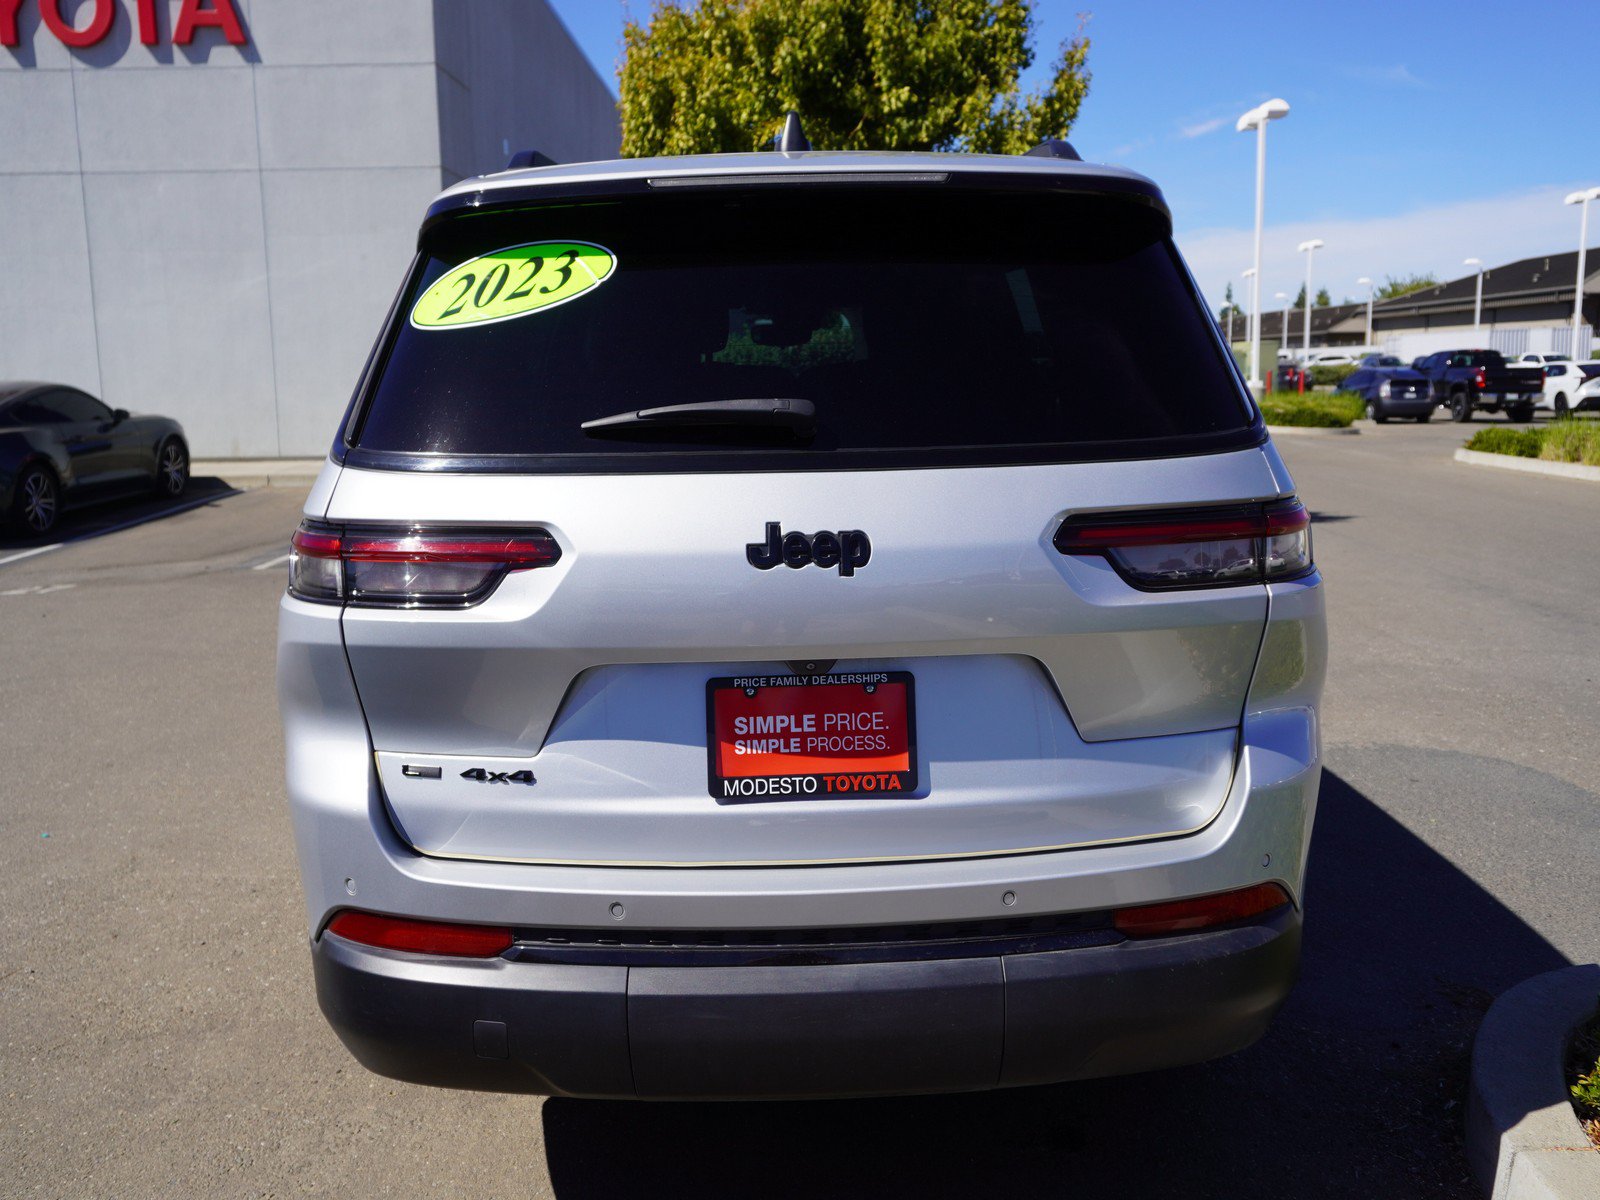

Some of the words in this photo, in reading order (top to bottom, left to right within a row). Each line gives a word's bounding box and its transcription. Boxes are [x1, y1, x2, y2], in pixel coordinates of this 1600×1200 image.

[437, 250, 579, 321] 2023
[746, 522, 872, 577] Jeep
[733, 677, 767, 688] PRICE
[770, 675, 808, 687] FAMILY
[812, 673, 888, 685] DEALERSHIPS
[734, 714, 816, 735] SIMPLE
[824, 711, 890, 731] PRICE.
[734, 737, 801, 755] SIMPLE
[807, 734, 890, 752] PROCESS.
[460, 768, 534, 783] 4x4
[723, 777, 817, 796] MODESTO
[823, 774, 902, 792] TOYOTA
